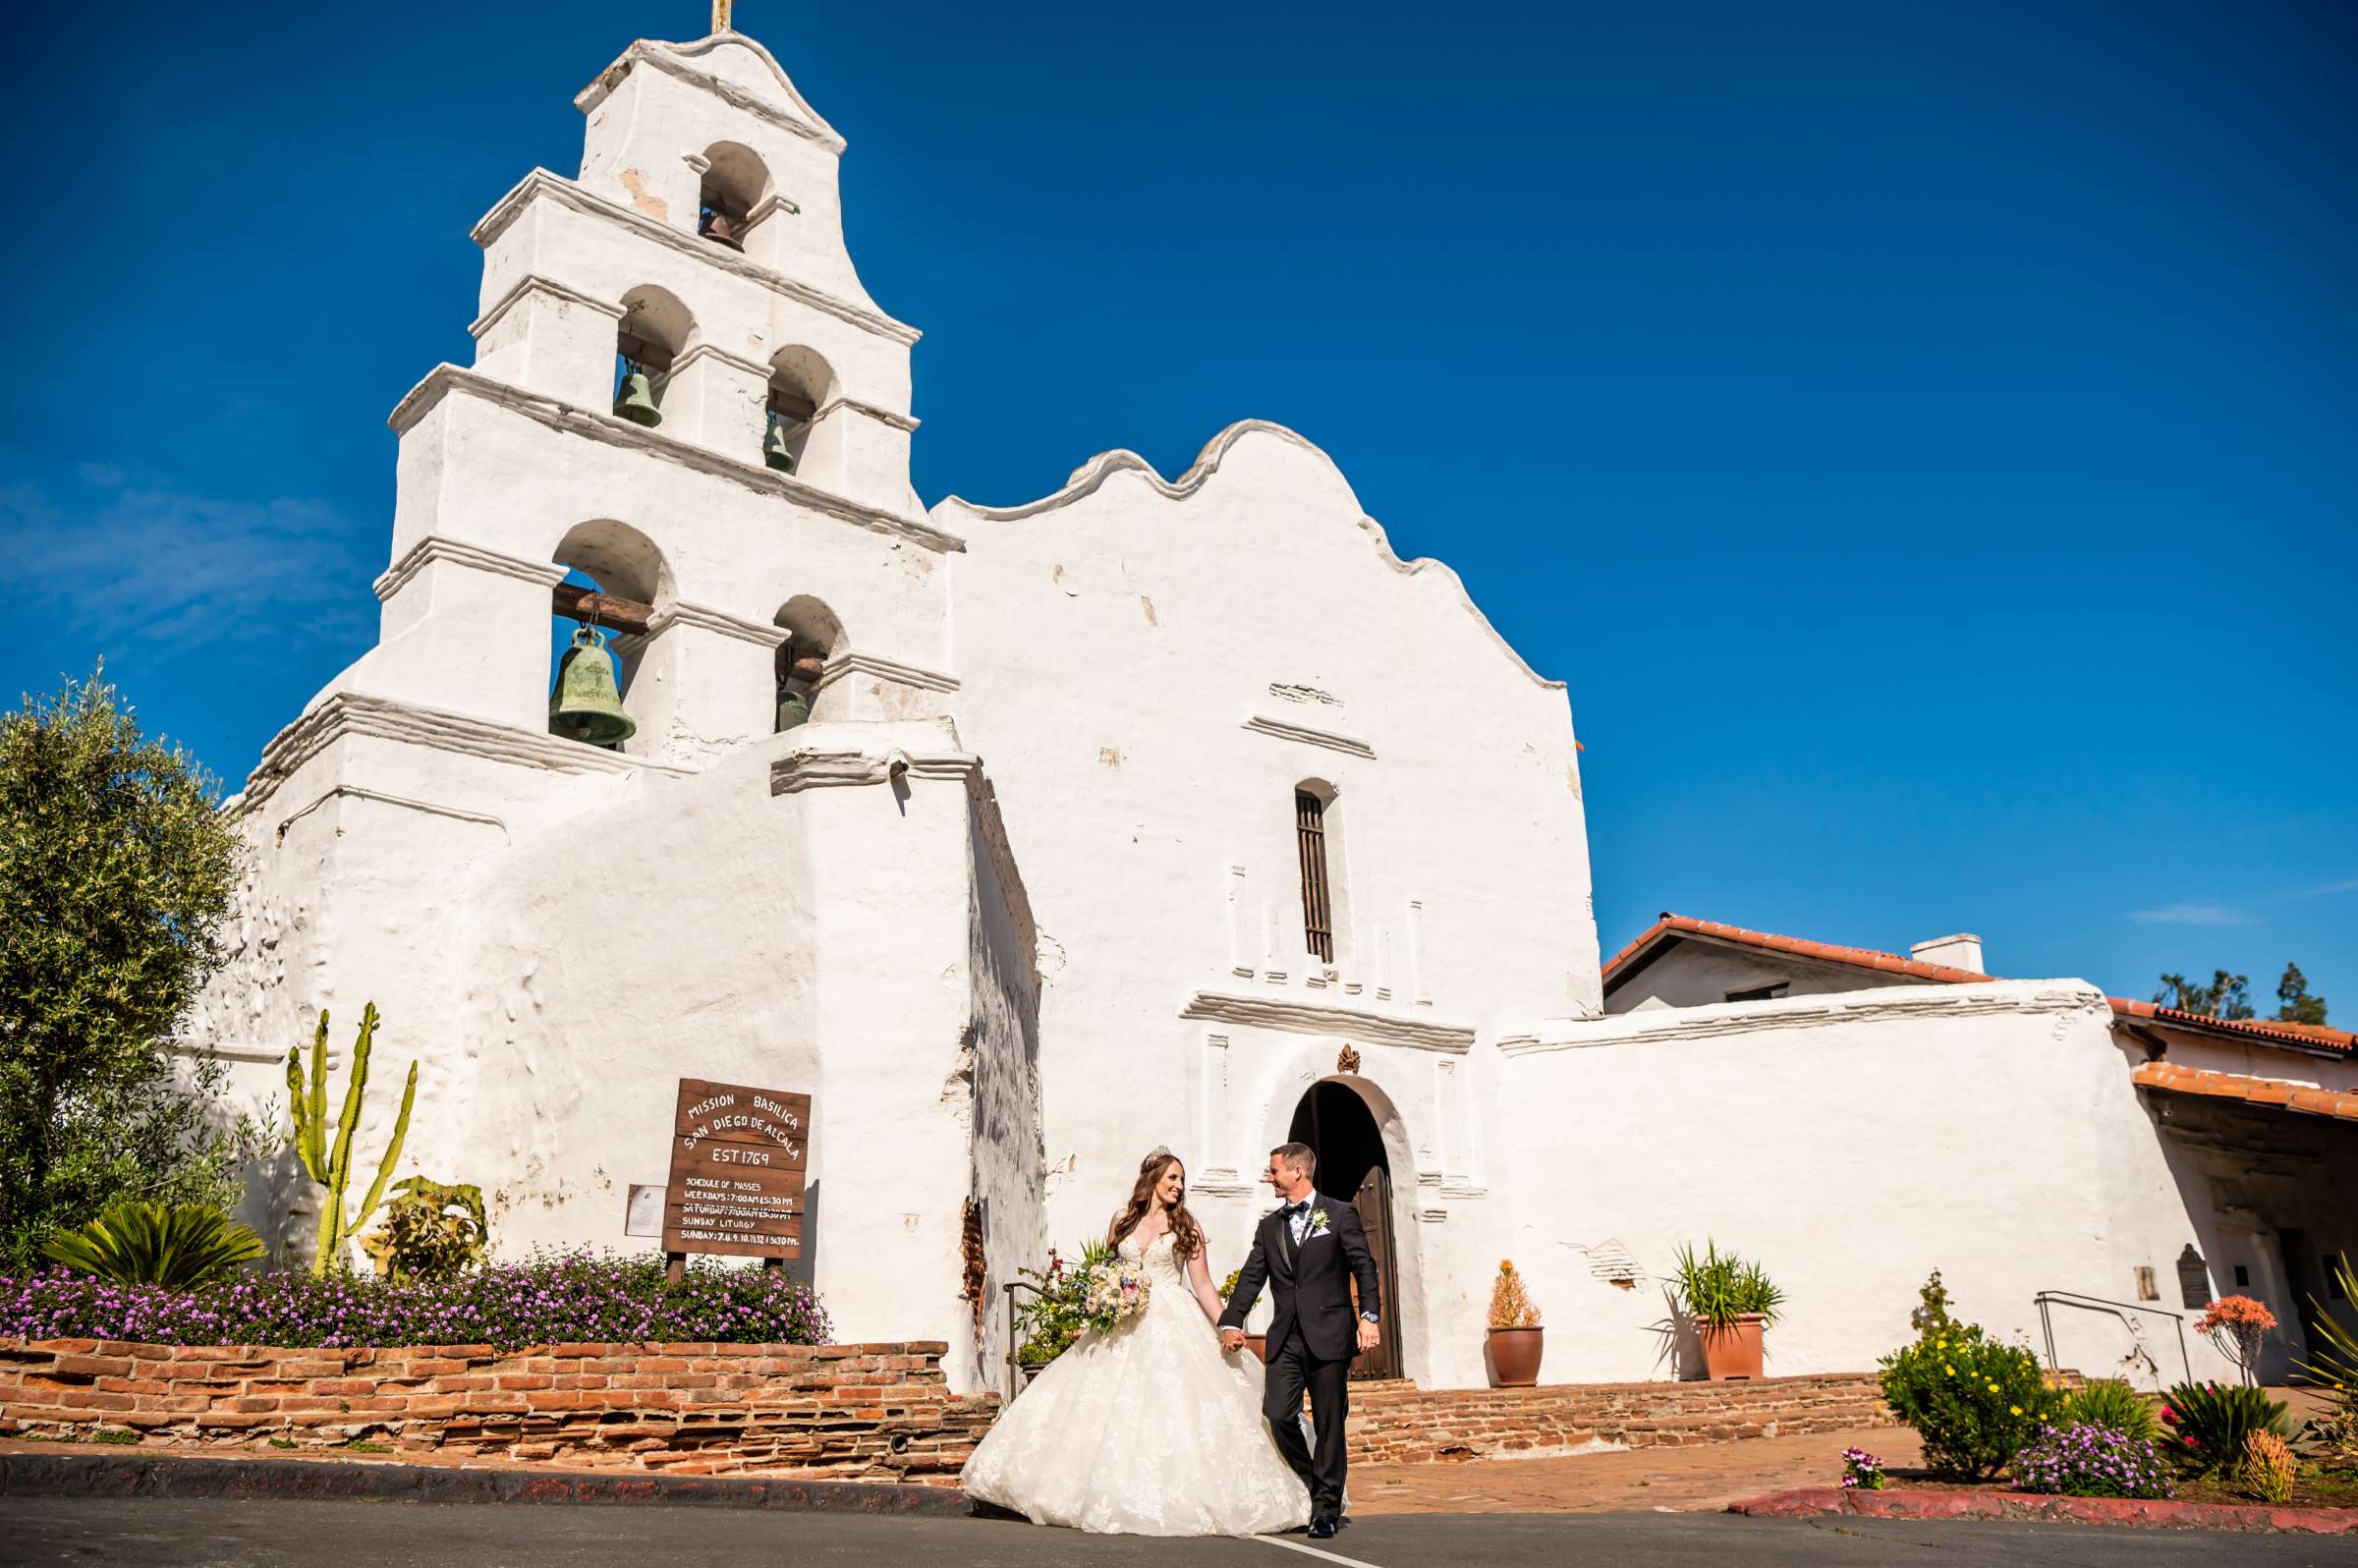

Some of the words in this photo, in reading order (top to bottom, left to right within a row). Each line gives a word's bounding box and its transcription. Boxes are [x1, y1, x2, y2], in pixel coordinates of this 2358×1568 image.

[688, 1093, 735, 1120] MISSION
[754, 1095, 798, 1130] BASILICA
[684, 1125, 708, 1149] SAN
[713, 1115, 748, 1131] DIEGO
[751, 1117, 765, 1130] DE
[763, 1124, 800, 1161] ALCALA
[712, 1148, 740, 1162] EST
[742, 1150, 769, 1166] 1769
[686, 1178, 720, 1189] SCHEDULE
[734, 1182, 761, 1192] MASSES
[682, 1217, 715, 1226] SUNDAY
[719, 1219, 756, 1229] LITURGY
